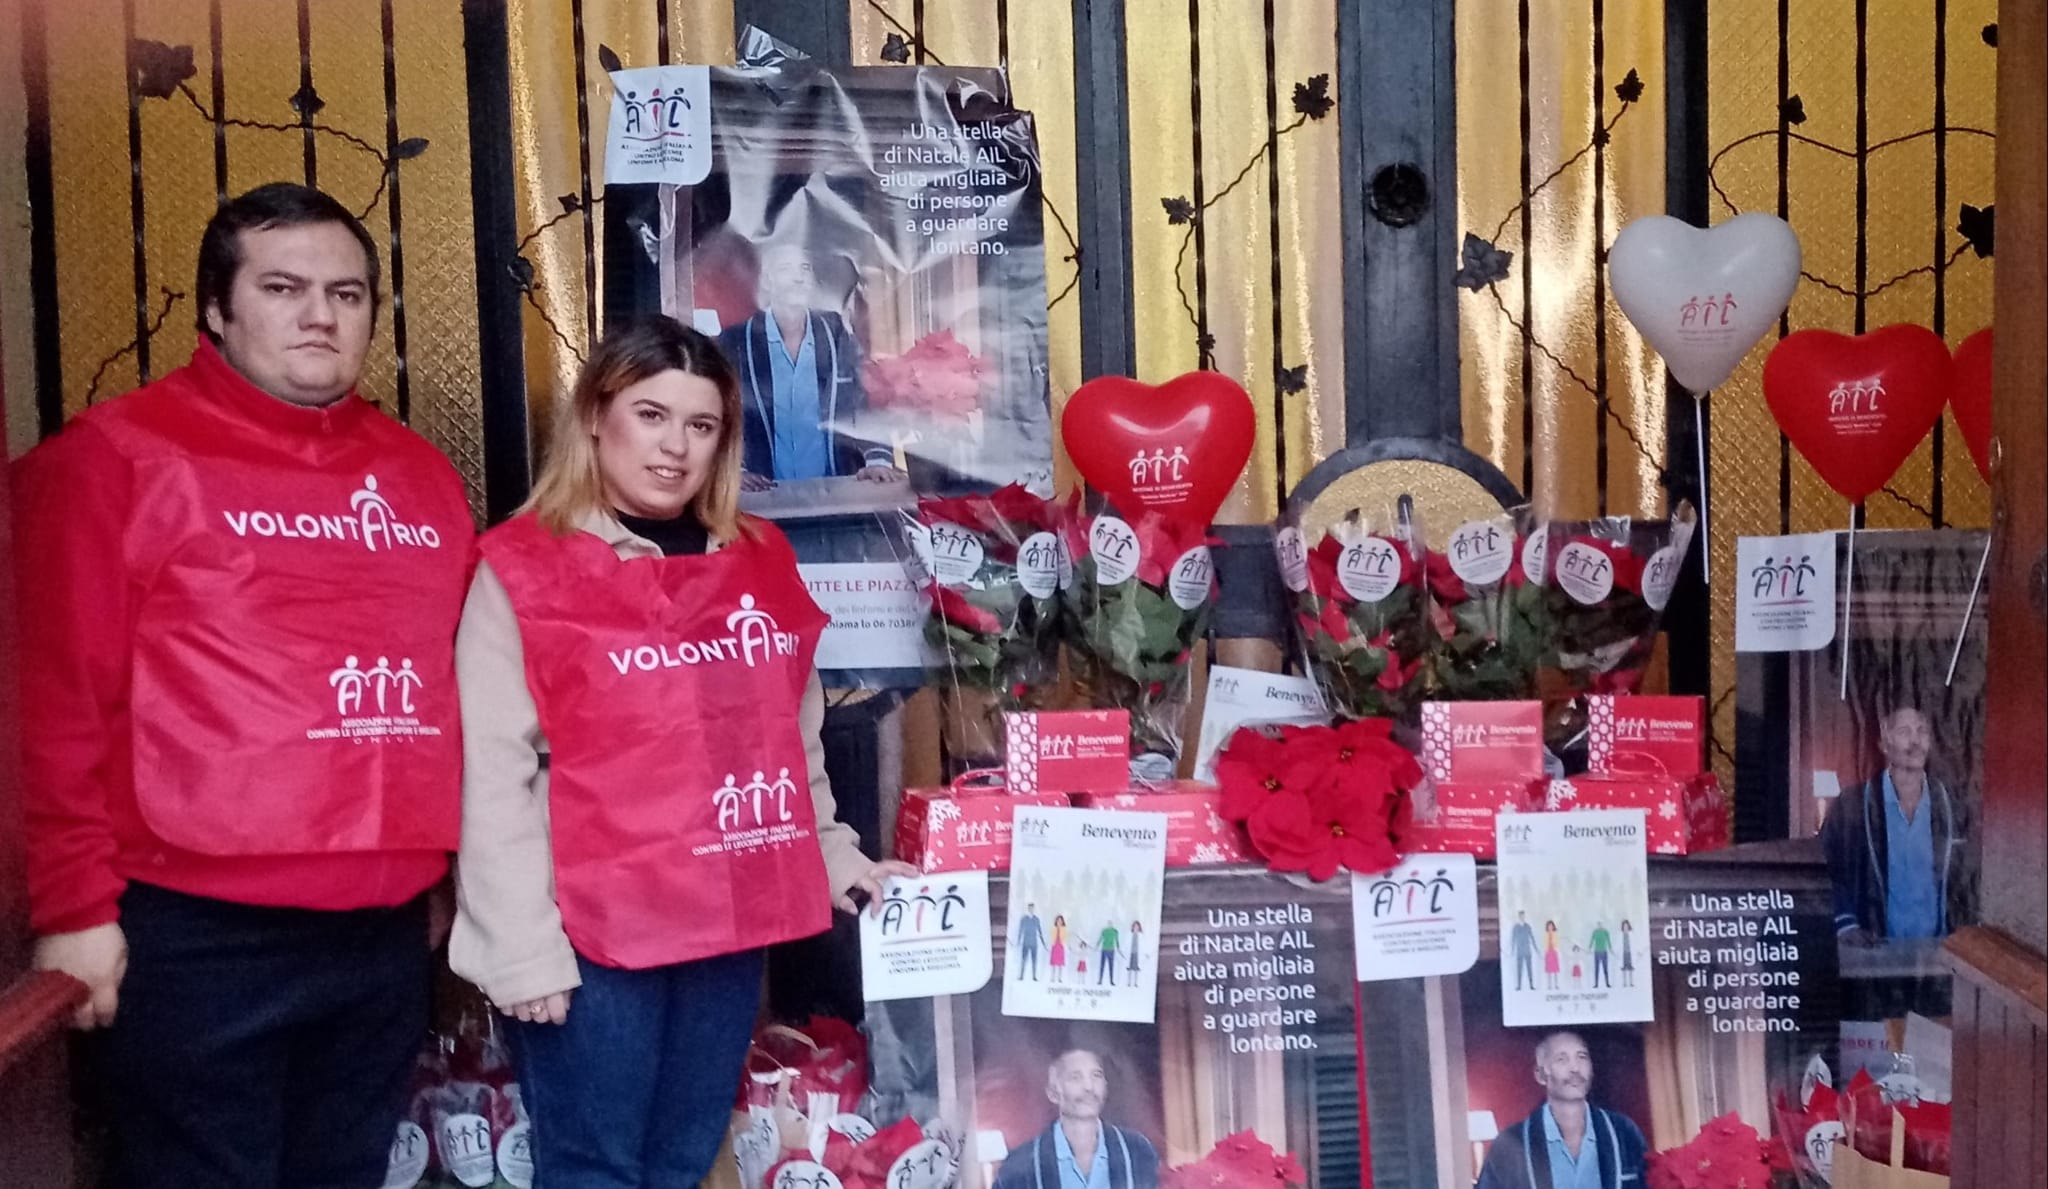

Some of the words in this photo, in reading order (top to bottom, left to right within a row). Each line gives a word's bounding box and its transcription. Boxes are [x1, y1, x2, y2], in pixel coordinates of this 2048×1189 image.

[626, 88, 691, 133] AIL
[911, 123, 947, 140] Una
[953, 121, 1001, 140] stella
[885, 145, 901, 163] di
[908, 146, 970, 163] Natale
[976, 147, 1006, 163] AIL
[880, 170, 927, 187] aiuta
[934, 170, 1006, 189] migliaia
[907, 193, 924, 209] di
[930, 194, 1007, 212] persone
[906, 219, 916, 232] a
[922, 213, 1008, 235] guardare
[930, 237, 1009, 255] lontano.
[1129, 446, 1189, 484] AIL
[223, 474, 440, 551] VOLONTARIO
[846, 580, 863, 592] LE
[1752, 555, 1815, 598] AIL
[329, 655, 422, 715] AIL
[712, 767, 796, 831] AIL
[1081, 823, 1157, 840] Benevento
[1563, 825, 1636, 839] Benevento
[1370, 869, 1454, 918] AIL
[1691, 893, 1732, 912] Una
[1737, 889, 1794, 910] stella
[883, 885, 965, 936] AIL
[1208, 909, 1250, 928] Una
[1255, 903, 1312, 925] stella
[1663, 919, 1682, 940] di
[1688, 916, 1758, 939] Natale
[1763, 916, 1798, 935] AIL
[1180, 935, 1199, 955] di
[1204, 931, 1275, 954] Natale
[1279, 930, 1315, 950] AIL
[1658, 946, 1711, 965] aiuta
[1717, 941, 1799, 966] migliaia
[1174, 961, 1228, 981] aiuta
[1232, 955, 1315, 980] migliaia
[1688, 969, 1707, 988] di
[1713, 971, 1800, 991] persone
[1204, 984, 1224, 1004] di
[1230, 984, 1316, 1007] persone
[1686, 996, 1698, 1011] a
[1704, 991, 1800, 1014] guardare
[1203, 1014, 1216, 1030] a
[1221, 1005, 1317, 1033] guardare
[1713, 1014, 1800, 1033] lontano.
[1230, 1033, 1318, 1054] lontano.
